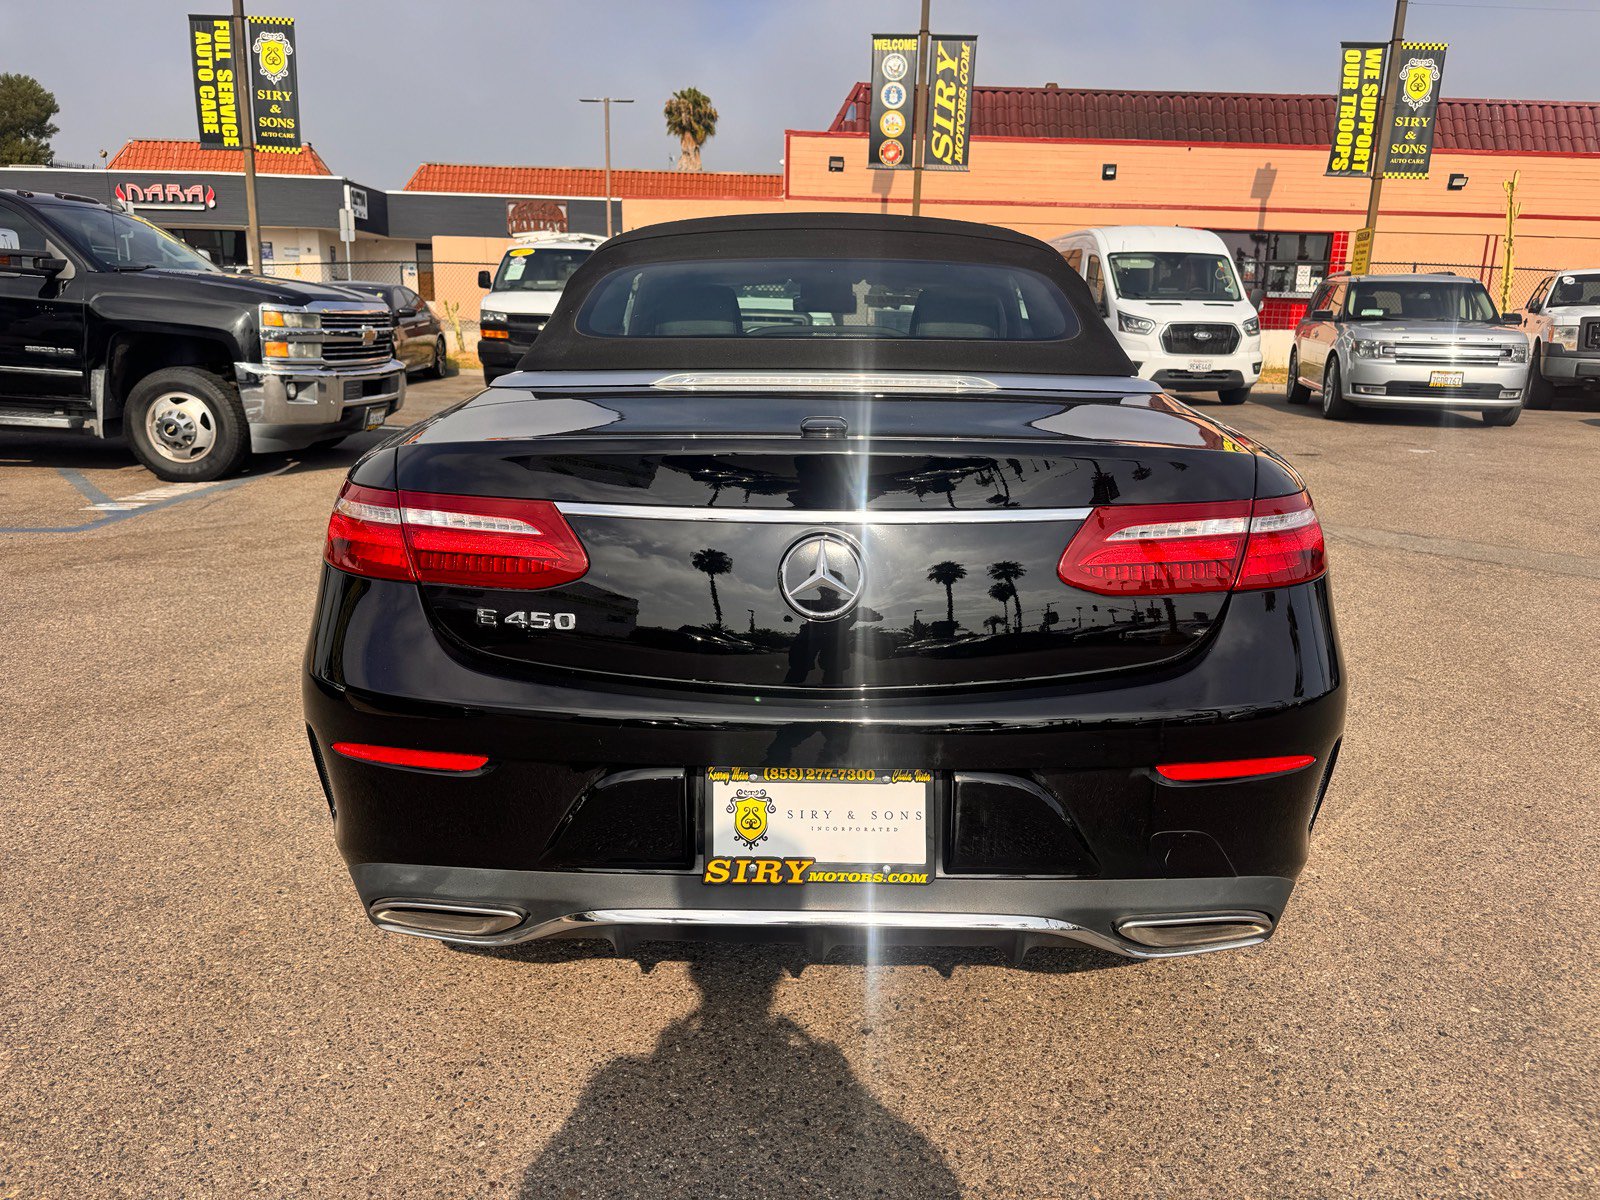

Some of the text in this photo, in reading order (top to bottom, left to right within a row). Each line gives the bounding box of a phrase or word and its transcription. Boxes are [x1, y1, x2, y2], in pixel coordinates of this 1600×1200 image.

[873, 38, 918, 51] WELCOME
[195, 31, 219, 134] AUTO CARE
[214, 20, 240, 147] FULL SERVICE
[257, 89, 293, 102] SIRY
[931, 40, 959, 165] SIRY
[954, 42, 971, 164] MOTORS.COM
[269, 104, 282, 113] &
[1331, 49, 1362, 171] OUR TROOPS
[1351, 48, 1383, 173] WE SUPPORT
[259, 116, 295, 129] SONS
[1394, 116, 1431, 128] SIRY
[1404, 130, 1417, 140] &
[1390, 143, 1427, 154] SONS
[126, 183, 205, 203] NARA
[476, 608, 576, 630] E 450
[787, 809, 923, 821] SIRY & SONS
